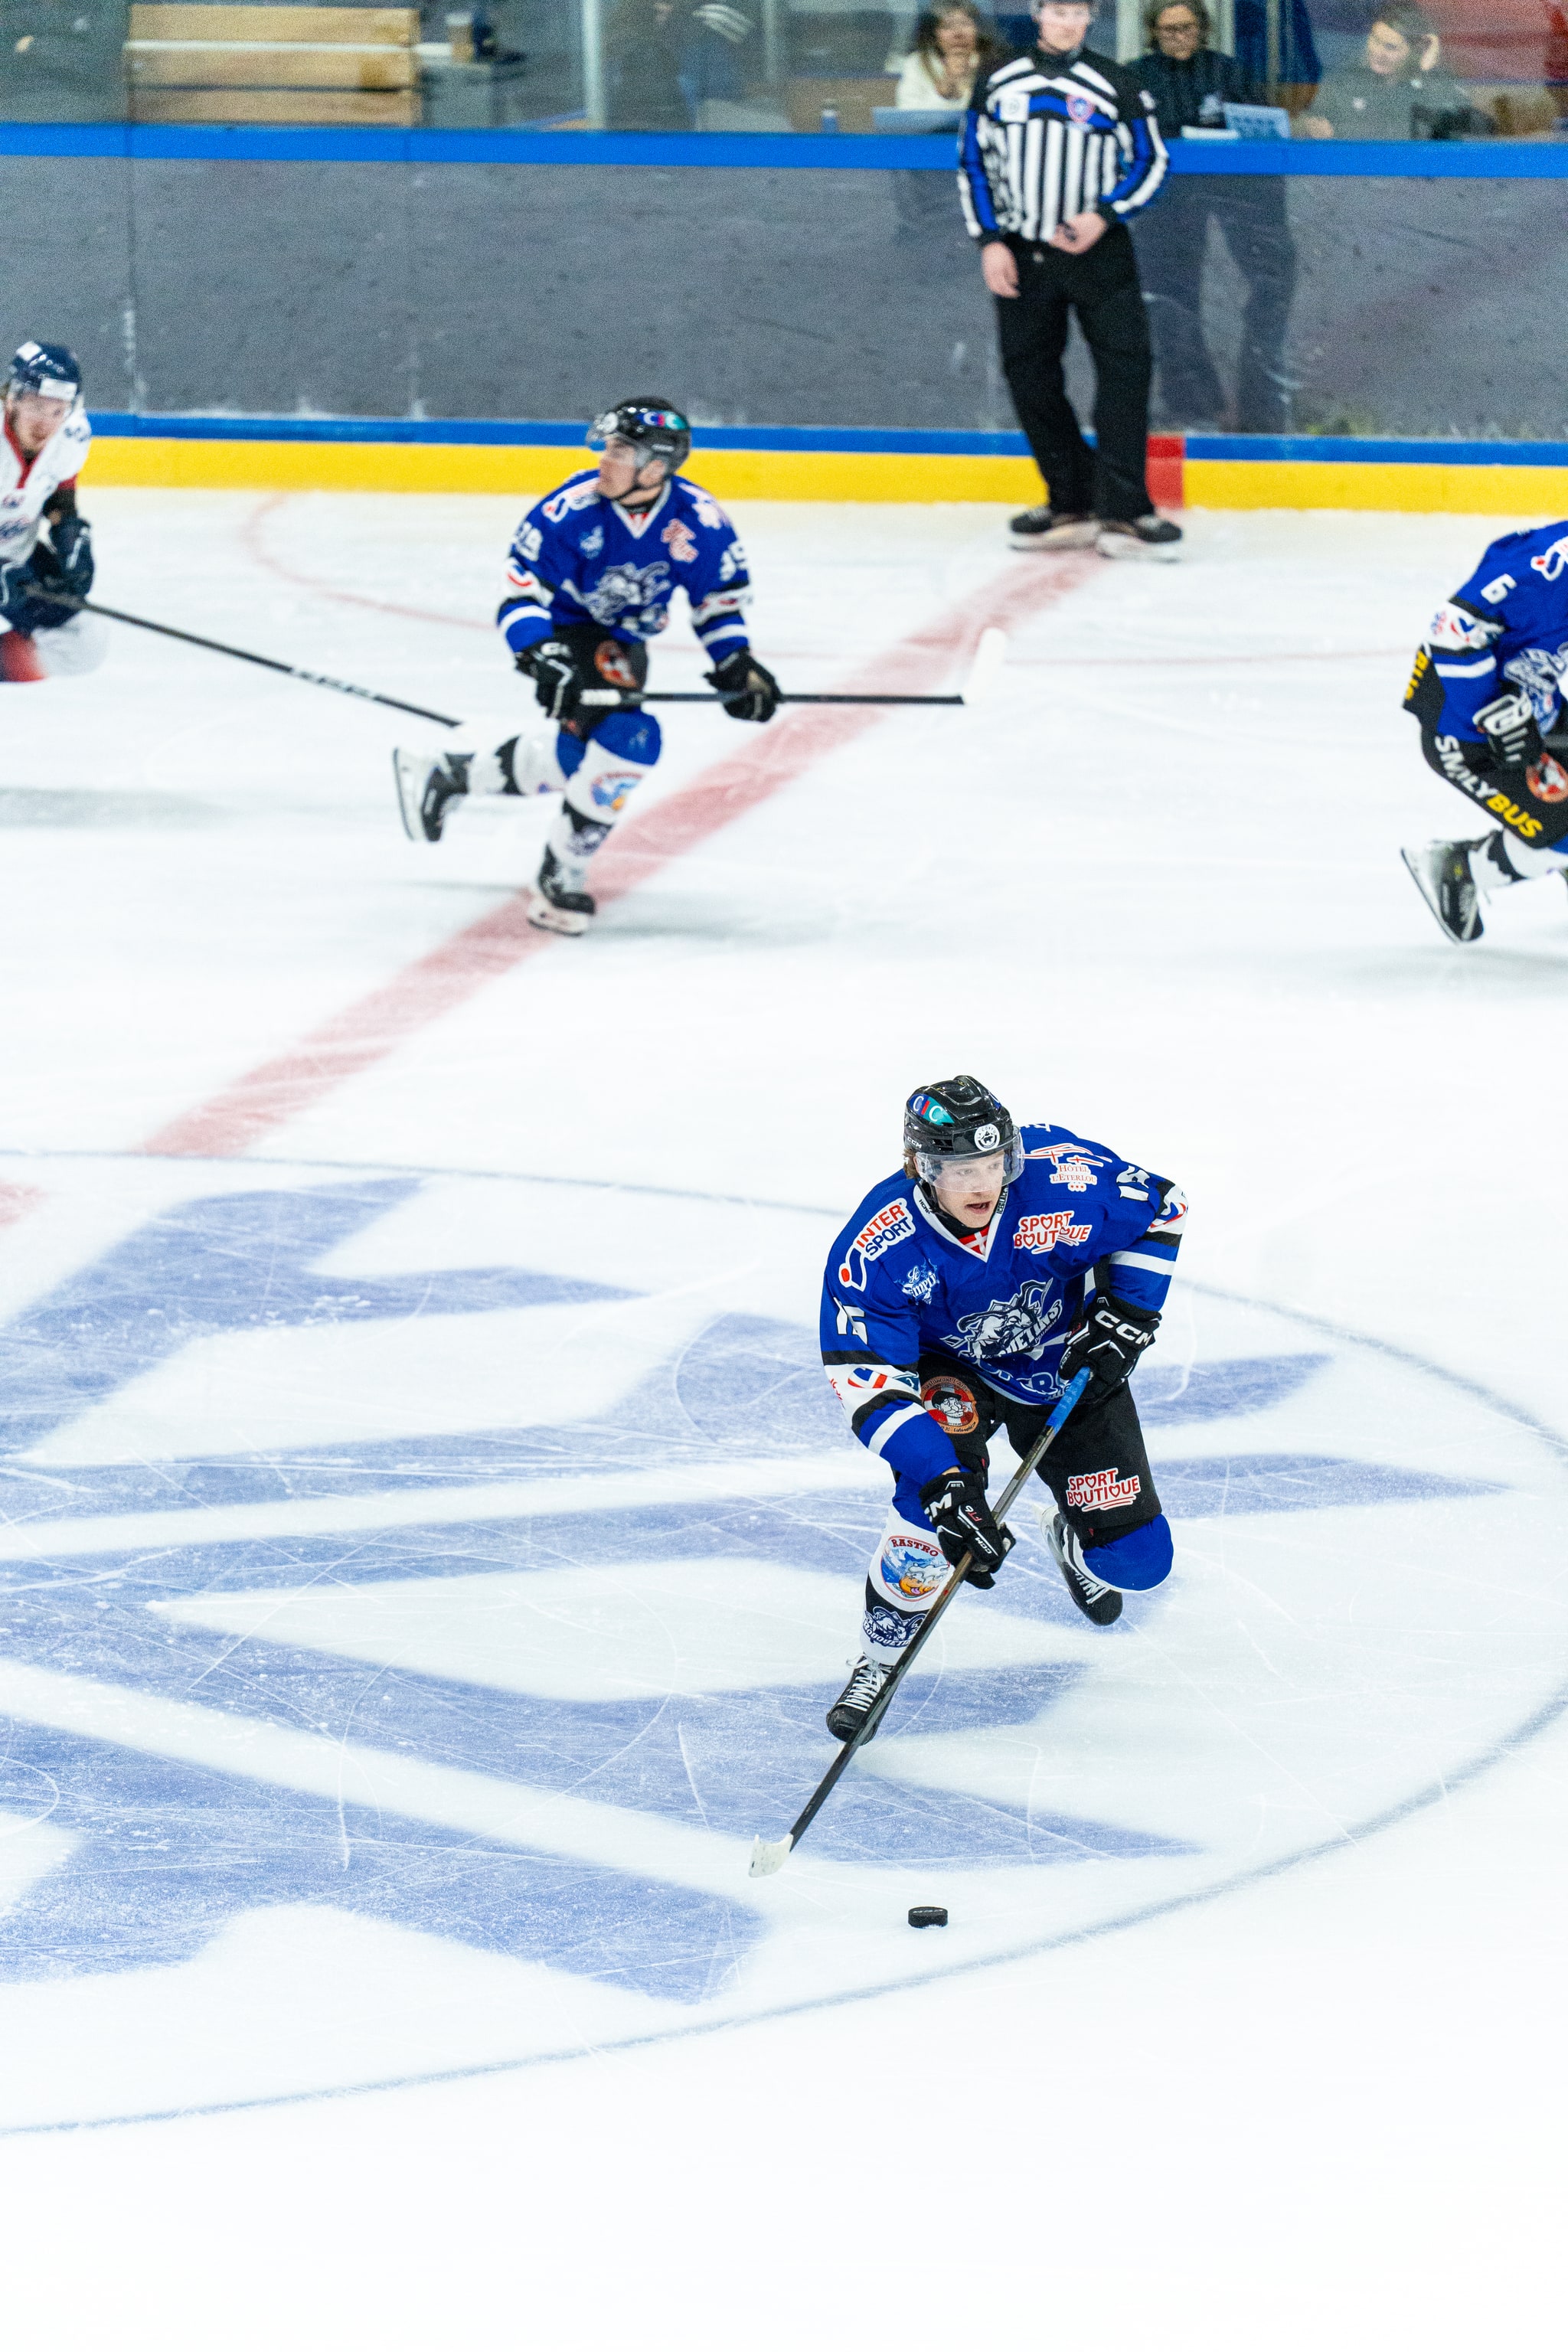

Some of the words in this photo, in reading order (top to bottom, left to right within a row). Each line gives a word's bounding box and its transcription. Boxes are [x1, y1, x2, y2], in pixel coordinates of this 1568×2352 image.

[1481, 573, 1517, 604] 6
[913, 1095, 943, 1122] CIC
[907, 1135, 923, 1149] CCM
[856, 1204, 905, 1249] INTER
[1021, 1212, 1073, 1233] SPORT
[865, 1217, 912, 1256] SPORT
[1095, 1310, 1153, 1346] CCM
[1067, 1478, 1139, 1504] BOUTIQUE
[1069, 1470, 1117, 1491] SPORT
[891, 1539, 939, 1557] RASTRO
[975, 1537, 993, 1554] CCM
